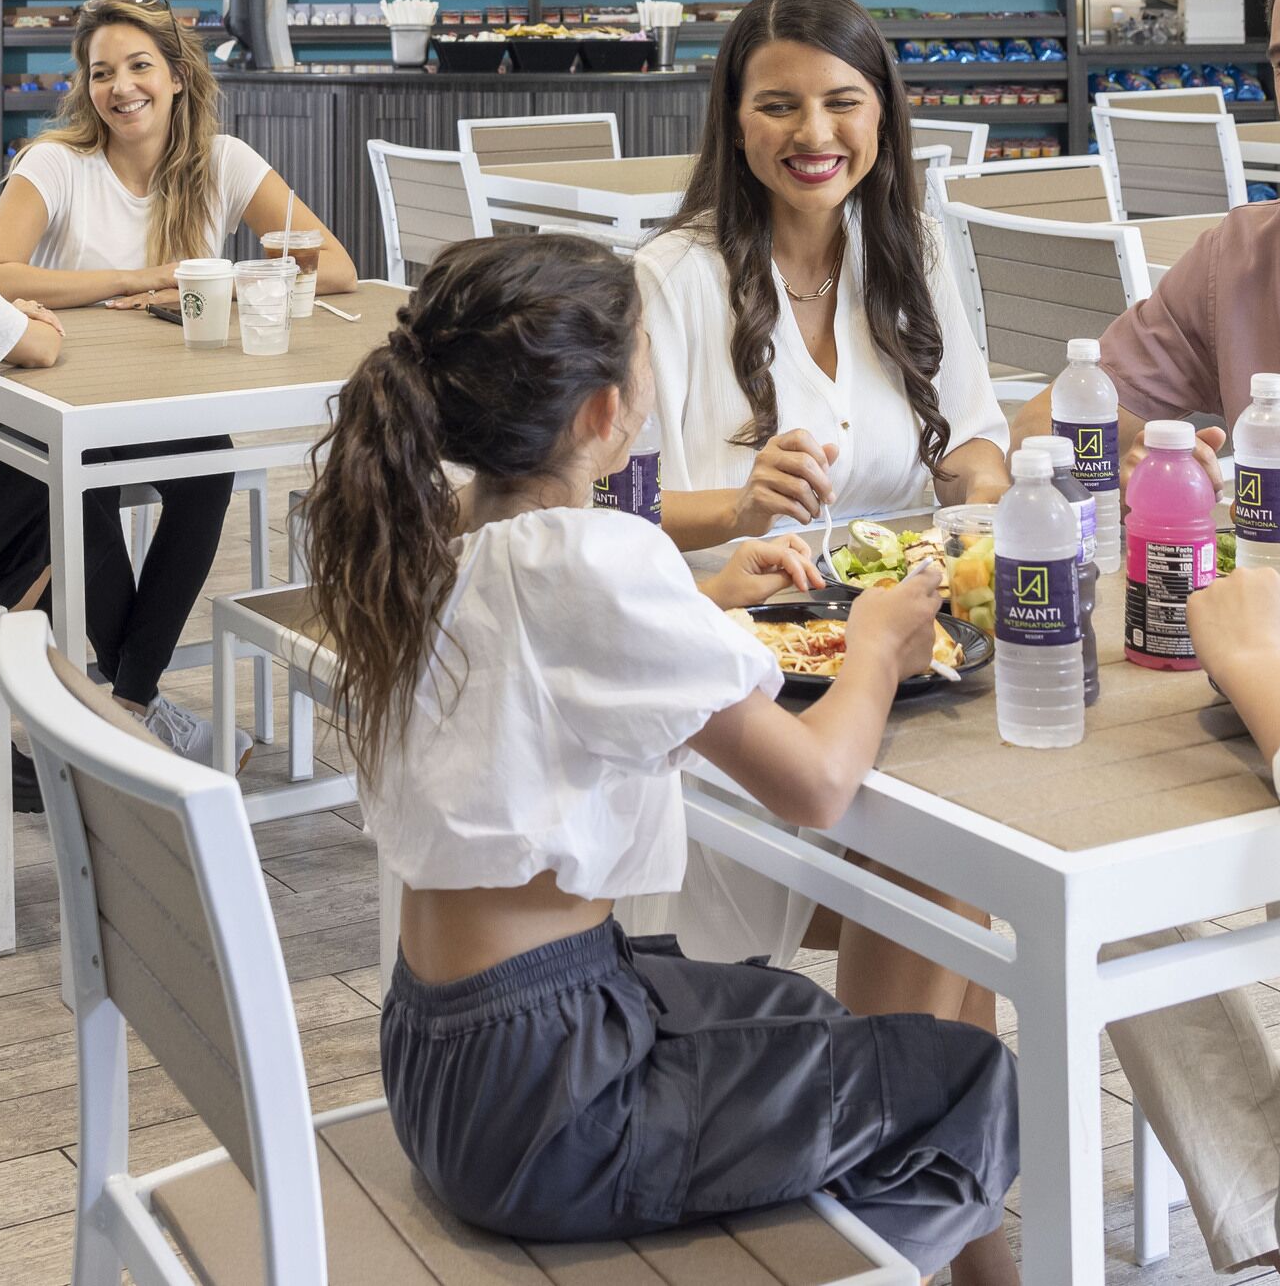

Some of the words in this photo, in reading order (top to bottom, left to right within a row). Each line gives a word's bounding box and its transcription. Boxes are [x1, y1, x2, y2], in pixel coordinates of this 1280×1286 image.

[1148, 544, 1175, 552] Nutrition
[1148, 561, 1169, 571] Calories
[1179, 562, 1193, 571] 100
[1008, 606, 1061, 621] AVANTI
[1003, 619, 1067, 629] INTERNATIONAL
